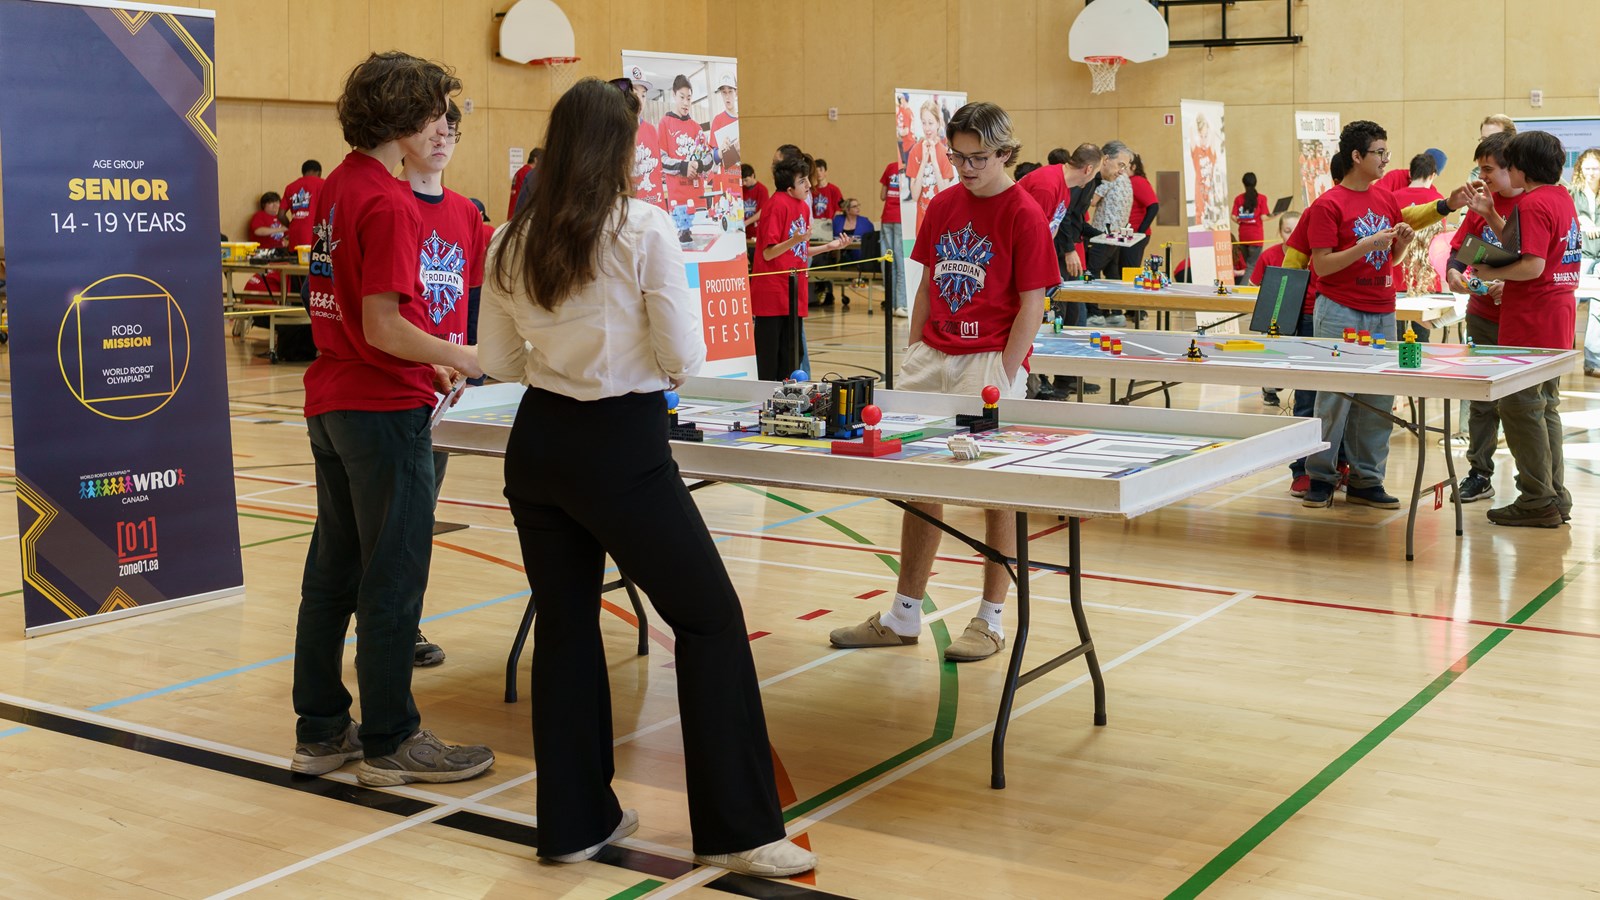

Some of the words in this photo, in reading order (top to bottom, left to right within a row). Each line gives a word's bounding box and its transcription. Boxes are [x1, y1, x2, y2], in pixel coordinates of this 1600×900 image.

[92, 160, 112, 169] AGE
[113, 160, 145, 169] GROUP
[68, 178, 169, 201] SENIOR
[51, 212, 77, 233] 14
[94, 212, 118, 233] 19
[123, 212, 187, 232] YEARS
[940, 262, 981, 277] MERODIAN
[705, 277, 746, 294] PROTOTYPE
[707, 297, 748, 317] CODE
[111, 324, 143, 336] ROBO
[708, 322, 750, 344] TEST
[103, 336, 152, 349] MISSION
[102, 367, 130, 377] WORLD
[130, 365, 154, 374] ROBOT
[121, 495, 150, 504] CANADA
[1436, 487, 1442, 506] A
[119, 559, 159, 577] zone01.ca
